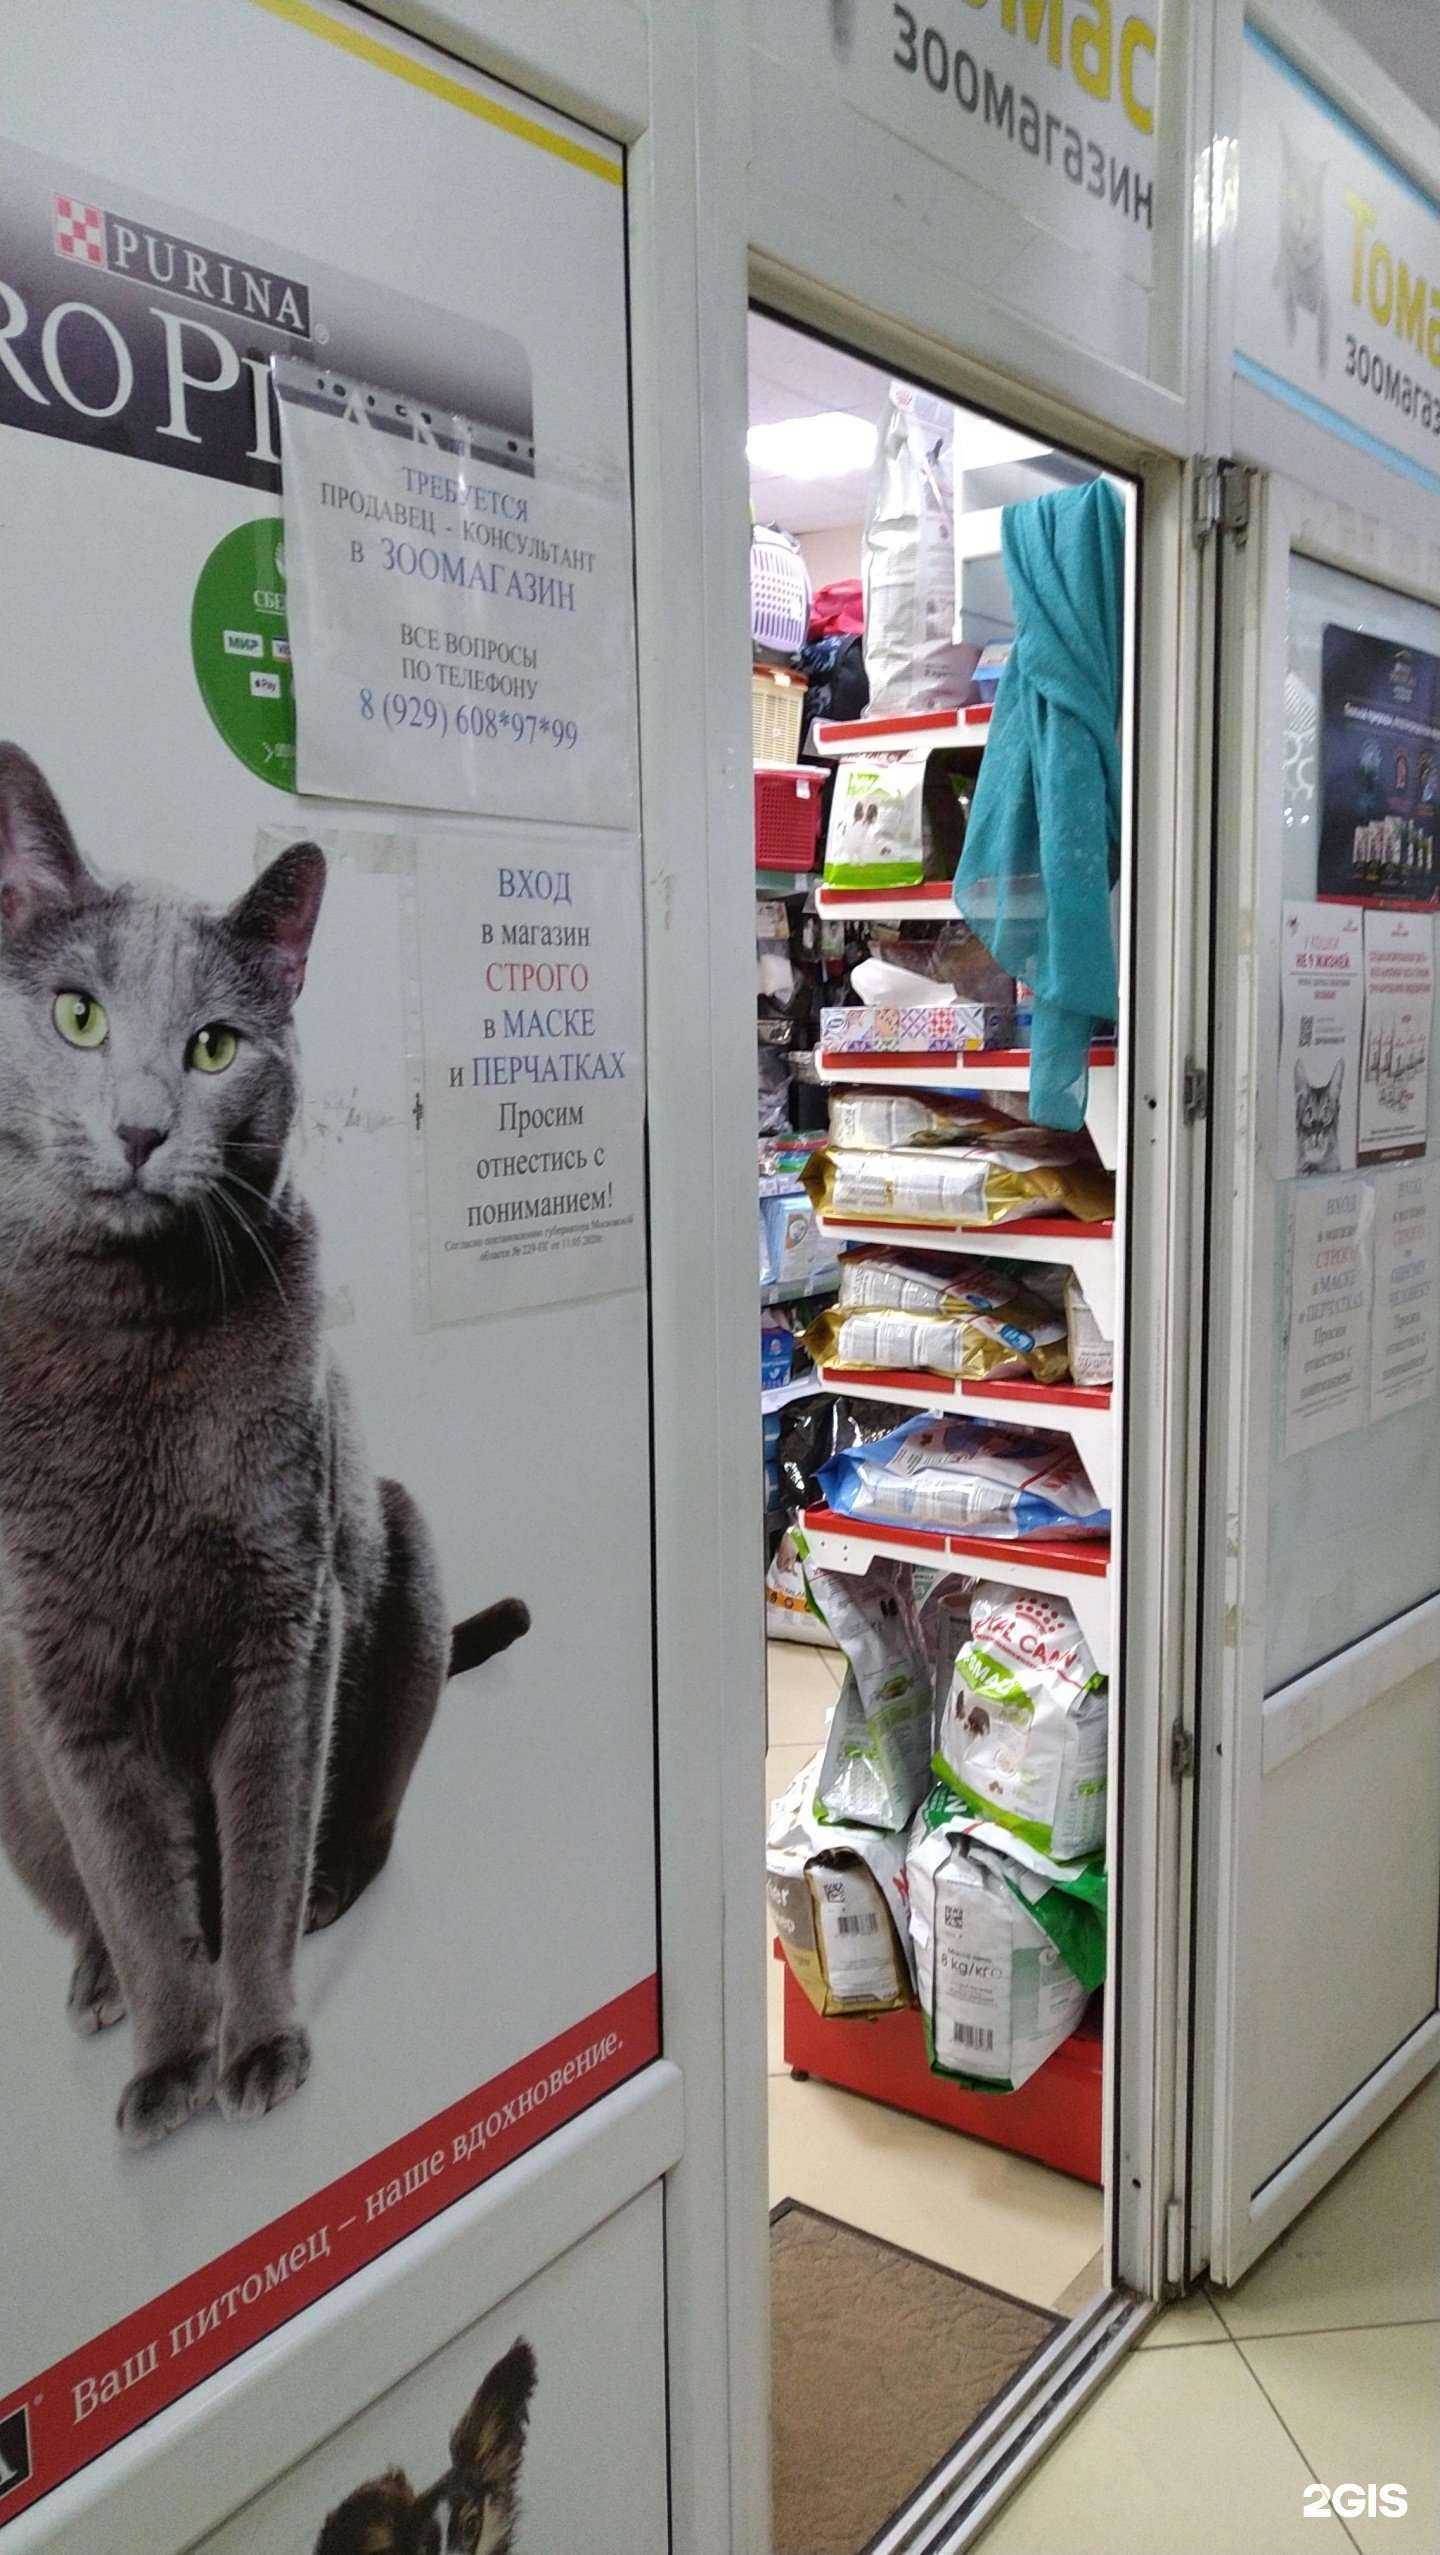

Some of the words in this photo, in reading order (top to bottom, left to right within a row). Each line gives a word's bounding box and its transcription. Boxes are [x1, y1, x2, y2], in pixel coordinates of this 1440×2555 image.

[962, 0, 1156, 135] мас
[893, 3, 1154, 230] зоомагазин
[113, 223, 305, 330] PURINA
[401, 466, 529, 523] ТРЕБУЕТСЯ
[319, 482, 436, 536] ПРОДАВЕЦ
[462, 520, 596, 573] КОНСУЛЬТАНТ
[381, 537, 576, 612] ЗООМАГАЗИН
[400, 623, 441, 651] ВСЕ
[445, 632, 537, 669] ВОПРОСЫ
[402, 657, 431, 682] ПО
[435, 663, 538, 700] ТЕЛЕФОНУ
[359, 687, 374, 720] 8
[382, 690, 448, 738] (929)
[498, 867, 573, 906] ВХОД
[481, 923, 494, 945] в
[501, 923, 591, 947] магазин
[485, 962, 589, 993] СТРОГО
[484, 1018, 496, 1039] в
[503, 1008, 596, 1039] МАСКЕ
[449, 1066, 464, 1088] и
[472, 1051, 626, 1087] ПЕРЧАТКАХ
[498, 1101, 584, 1138] Просим
[476, 1148, 588, 1180] отнестись
[593, 1146, 605, 1167] с
[466, 1181, 613, 1227] пониманием!
[71, 2338, 160, 2426] Ваш
[168, 2222, 332, 2360] питомец
[364, 2146, 446, 2223] наше
[451, 2030, 624, 2167] вдохновение.
